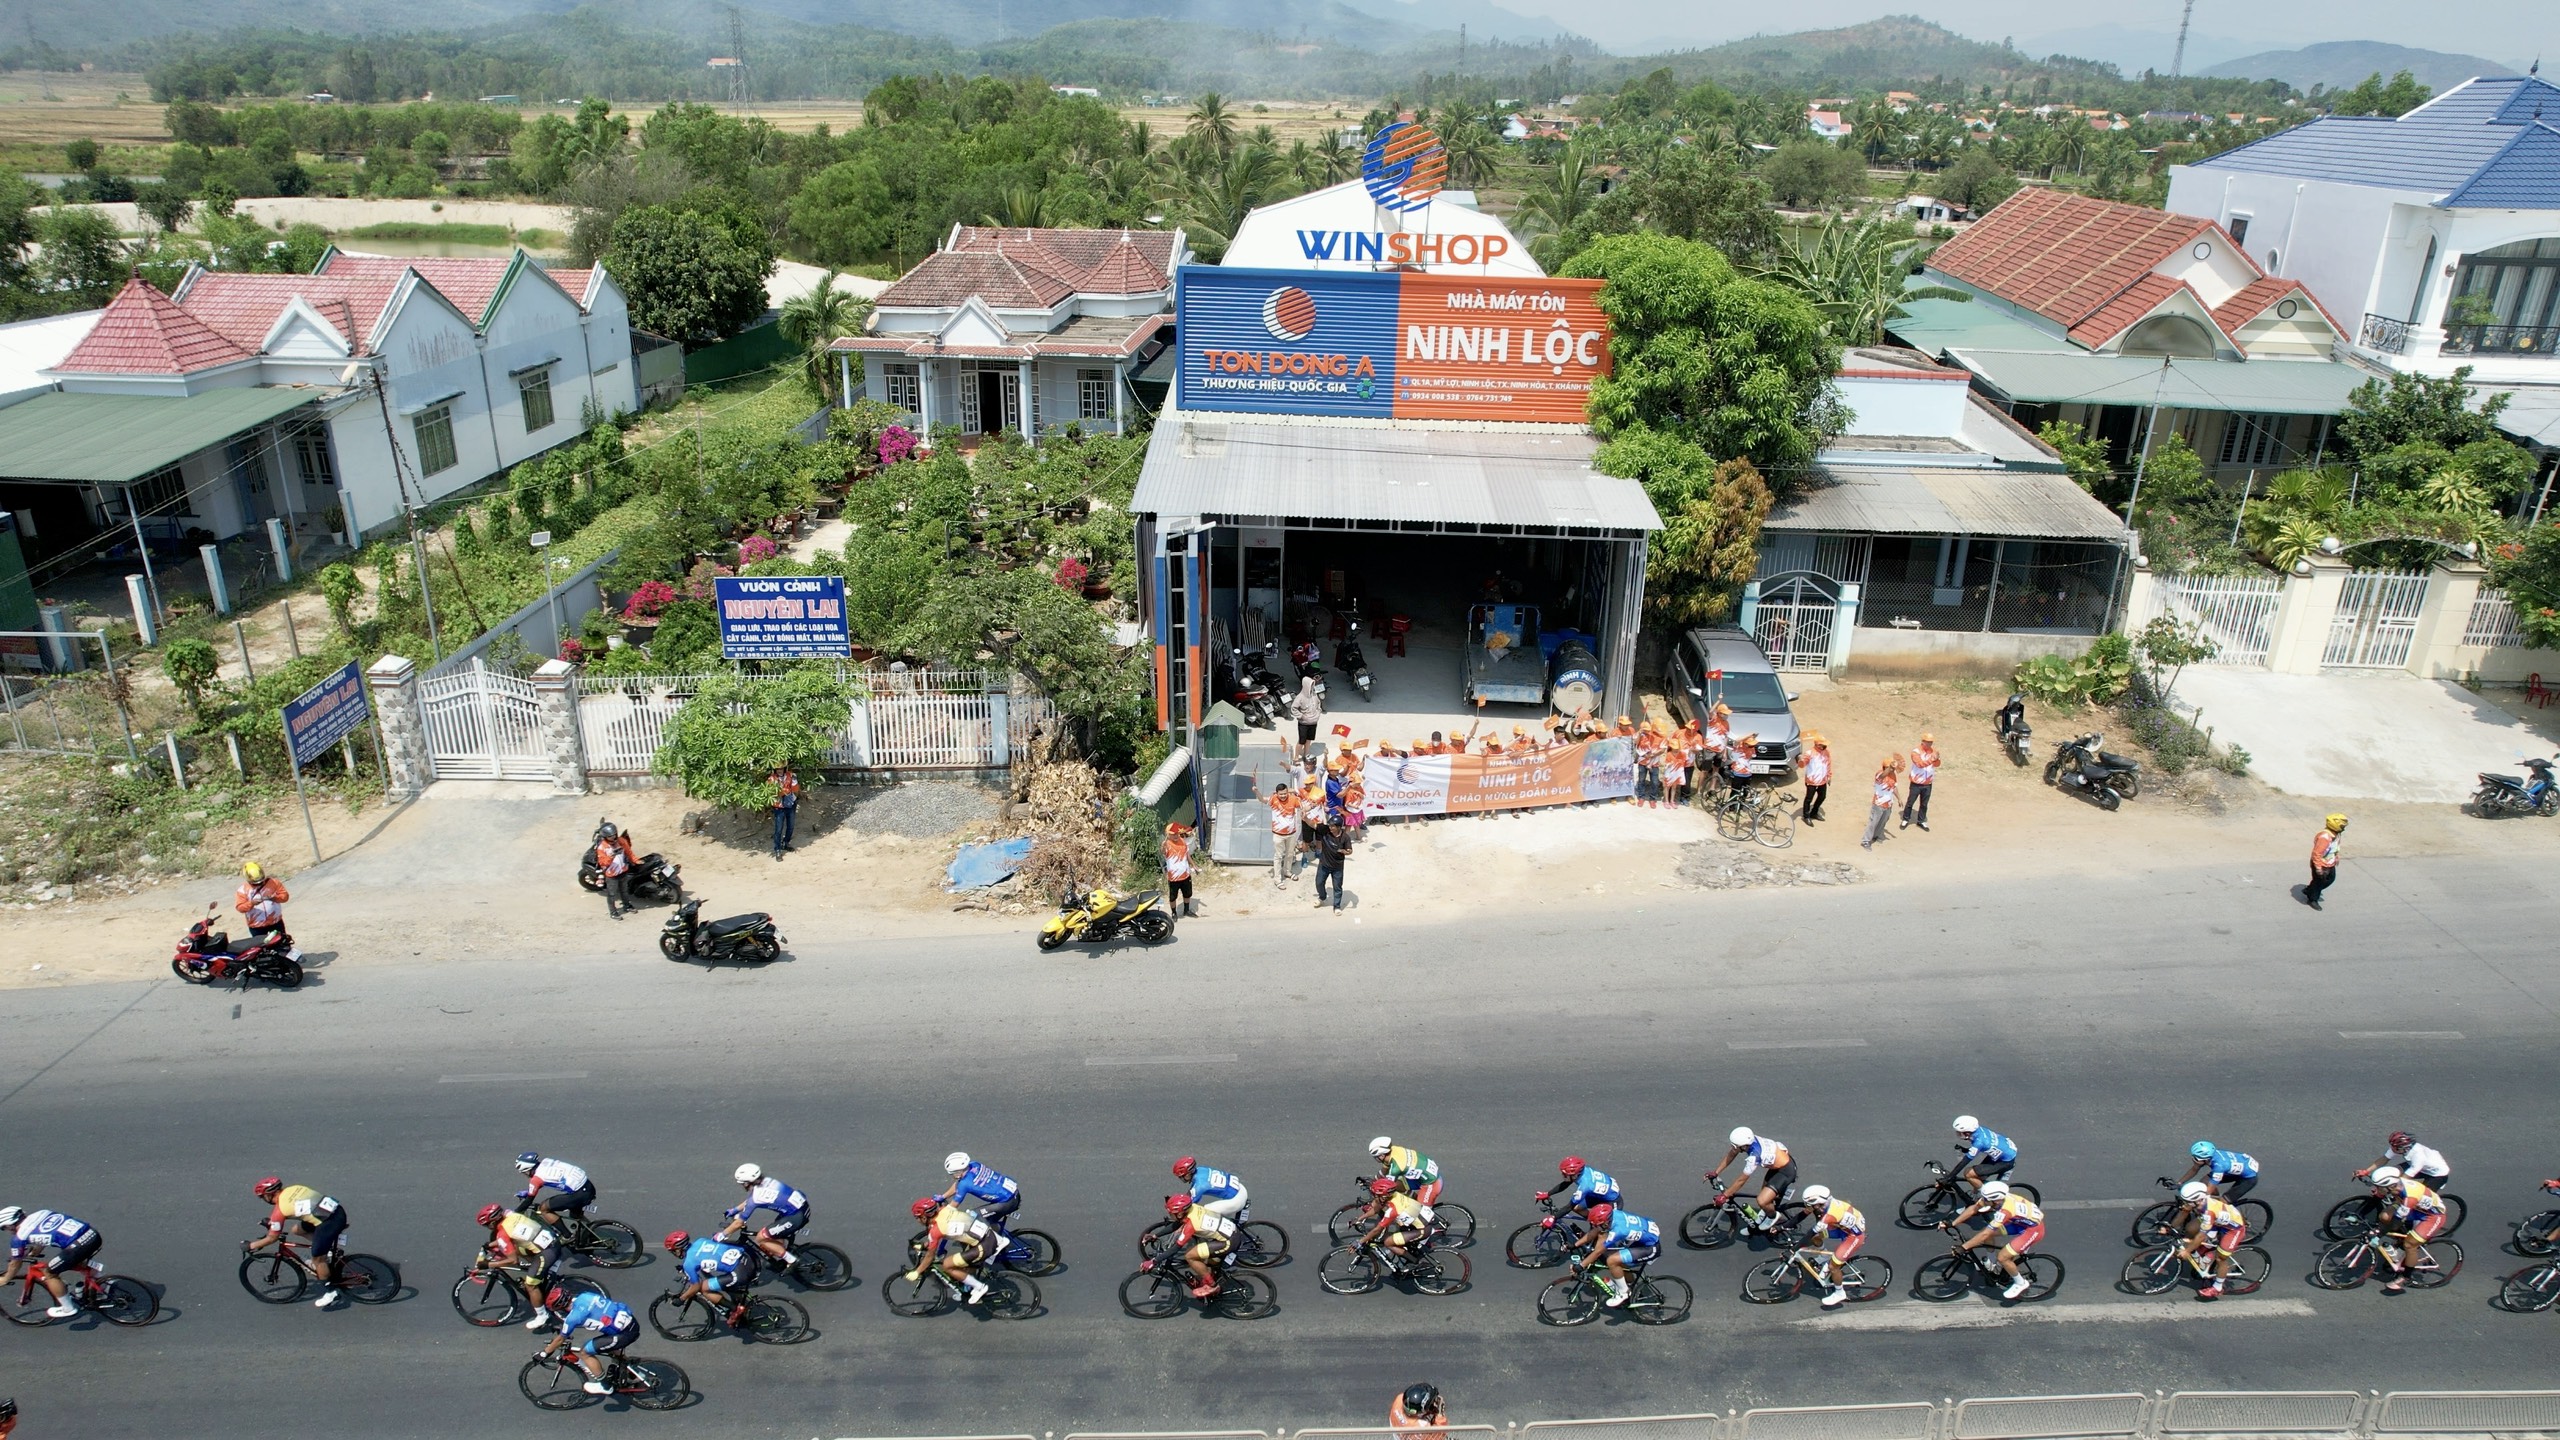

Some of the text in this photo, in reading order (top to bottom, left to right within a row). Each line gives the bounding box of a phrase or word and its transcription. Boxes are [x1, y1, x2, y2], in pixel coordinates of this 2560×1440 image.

[1447, 289, 1566, 312] NHÀ MÁY TÔN
[1406, 318, 1601, 375] NINH LỘC
[1203, 351, 1376, 377] TON DONG A
[1202, 377, 1348, 393] THƯƠNG HIỆU QUỐC GIA
[1555, 382, 1582, 391] KHÁNH
[724, 596, 840, 619] NGUYÊN LAI
[731, 624, 747, 632] GIAO
[763, 624, 780, 632] TRAO
[794, 623, 808, 632] CÁC
[825, 624, 838, 632] HOA
[727, 634, 740, 642] CÂY
[762, 634, 776, 642] CÂY
[1479, 766, 1553, 788] NINH LỘC
[1370, 789, 1441, 799] TON DONG A
[1452, 792, 1482, 803] CHÀO
[1484, 791, 1517, 801] MỪNG
[1551, 785, 1573, 795] ĐUA
